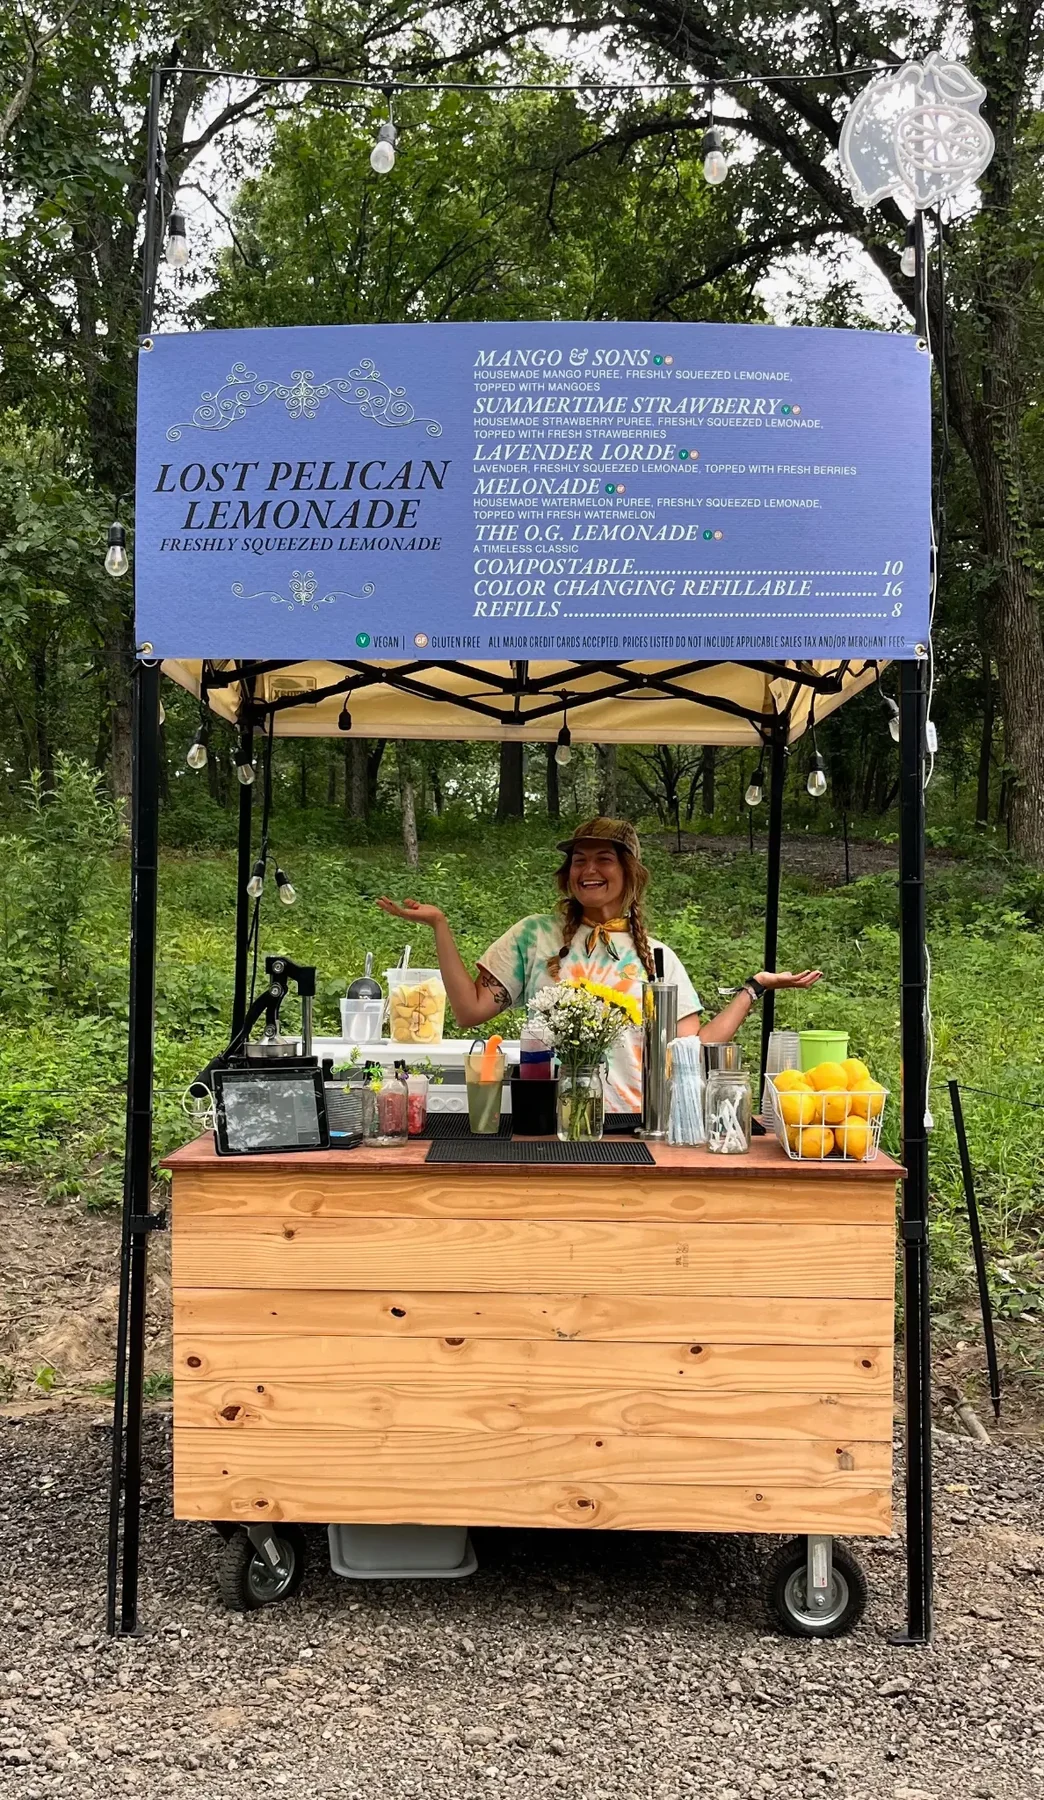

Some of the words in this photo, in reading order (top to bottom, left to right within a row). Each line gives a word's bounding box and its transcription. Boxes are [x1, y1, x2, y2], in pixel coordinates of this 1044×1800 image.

[473, 349, 562, 367] MANGO
[569, 348, 589, 367] &
[592, 349, 650, 367] SONS
[474, 370, 540, 379] HOUSEMADE
[543, 370, 582, 379] MANGO
[626, 370, 672, 379] FRESHLY
[675, 370, 731, 380] SQUEEZED
[734, 371, 793, 382] LEMONADE,
[474, 382, 515, 392] TOPPED
[518, 382, 545, 392] WITH
[548, 382, 600, 392] MANGOES
[473, 397, 628, 414] SUMMERTIME
[630, 397, 783, 415] STRAWBERRY
[474, 417, 539, 426] HOUSEMADE
[542, 417, 614, 426] STRAWBERRY
[658, 417, 703, 426] FRESHLY
[707, 418, 762, 427] SQUEEZED
[765, 419, 824, 429] LEMONADE,
[474, 430, 515, 439] TOPPED
[518, 430, 544, 439] WITH
[547, 430, 582, 439] FRESH
[585, 430, 667, 439] STRAWBERRIES
[473, 444, 593, 461] LAVENDER
[599, 444, 676, 461] LORDE
[153, 461, 260, 493] LOST
[265, 460, 452, 491] PELICAN
[473, 464, 531, 474] LAVENDER,
[534, 464, 580, 473] FRESHLY
[582, 464, 638, 473] SQUEEZED
[642, 464, 701, 474] LEMONADE,
[705, 464, 746, 473] TOPPED
[749, 464, 774, 473] WITH
[777, 465, 811, 474] FRESH
[813, 466, 857, 475] BERRIES
[472, 478, 601, 495] MELONADE
[473, 498, 538, 507] HOUSEMADE
[541, 498, 613, 507] WATERMELON
[657, 498, 703, 507] FRESHLY
[705, 498, 761, 507] SQUEEZED
[764, 499, 822, 509] LEMONADE,
[181, 499, 421, 530] LEMONADE
[474, 511, 515, 520] TOPPED
[518, 511, 544, 520] WITH
[547, 511, 581, 520] FRESH
[584, 511, 656, 520] WATERMELON
[475, 524, 519, 541] THE
[524, 524, 564, 541] O.G.
[571, 524, 698, 541] LEMONADE
[160, 537, 238, 551] FRESHLY
[241, 537, 333, 555] SQUEEZED
[339, 537, 442, 551] LEMONADE
[473, 545, 480, 553] A
[482, 545, 532, 553] TIMELESS
[535, 545, 579, 553] CLASSIC
[881, 560, 904, 576] 10
[473, 579, 546, 596] COLOR
[553, 579, 676, 596] CHANGING
[680, 579, 812, 596] REFILLABLE
[882, 581, 904, 597] 16
[472, 601, 561, 617] REFILLS
[891, 602, 903, 618] 8
[373, 636, 399, 648] VEGAN
[432, 636, 461, 648] GLUTEN
[463, 636, 481, 648] FREE
[489, 636, 500, 648] ALL
[502, 636, 528, 648] MAJOR
[529, 636, 554, 648] CREDIT
[557, 636, 580, 648] CARDS
[623, 636, 648, 648] PRICES
[650, 636, 674, 648] LISTED
[676, 636, 686, 648] DO
[688, 636, 702, 648] NOT
[704, 636, 734, 648] INCLUDE
[736, 636, 779, 648] APPLICABLE
[780, 636, 802, 648] SALES
[804, 636, 817, 648] TAX
[818, 636, 846, 649] AND/OR
[848, 636, 887, 648] MERCHANT
[888, 636, 905, 648] FEES
